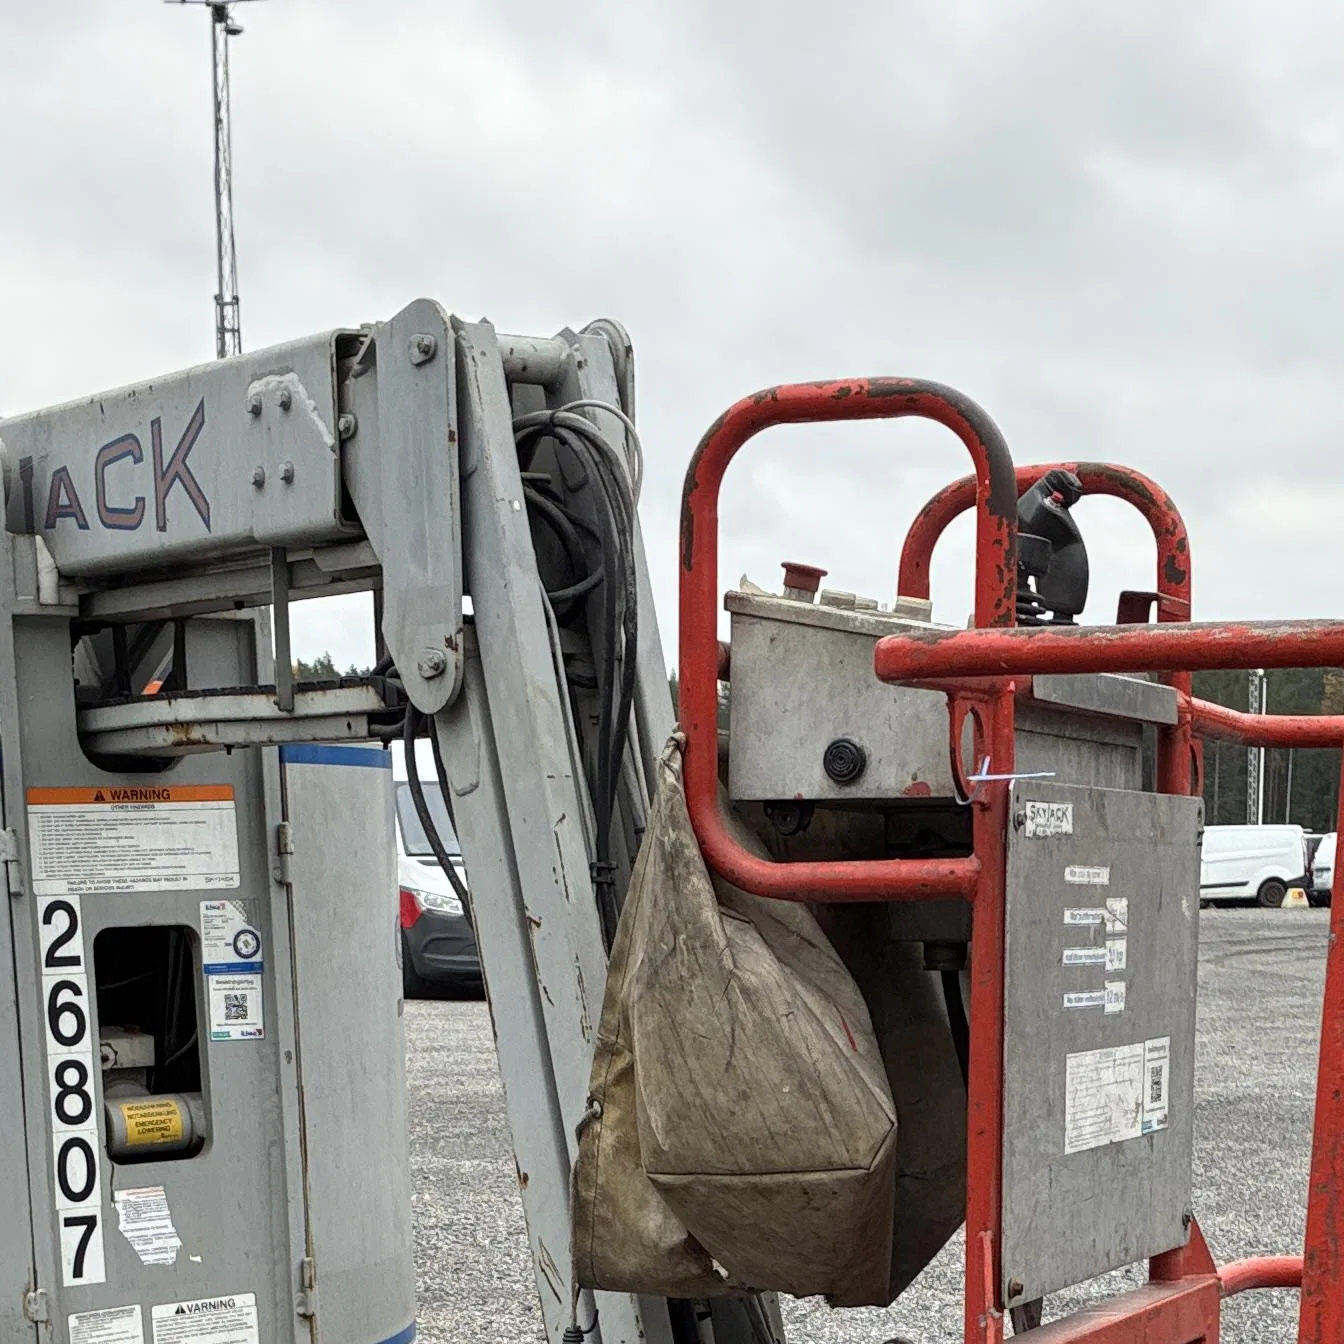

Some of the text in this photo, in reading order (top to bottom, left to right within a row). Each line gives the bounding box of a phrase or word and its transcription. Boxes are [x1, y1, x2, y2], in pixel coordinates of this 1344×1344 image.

[110, 788, 171, 801] WARNING
[42, 899, 98, 1279] 26807
[187, 1298, 236, 1315] VARNING
